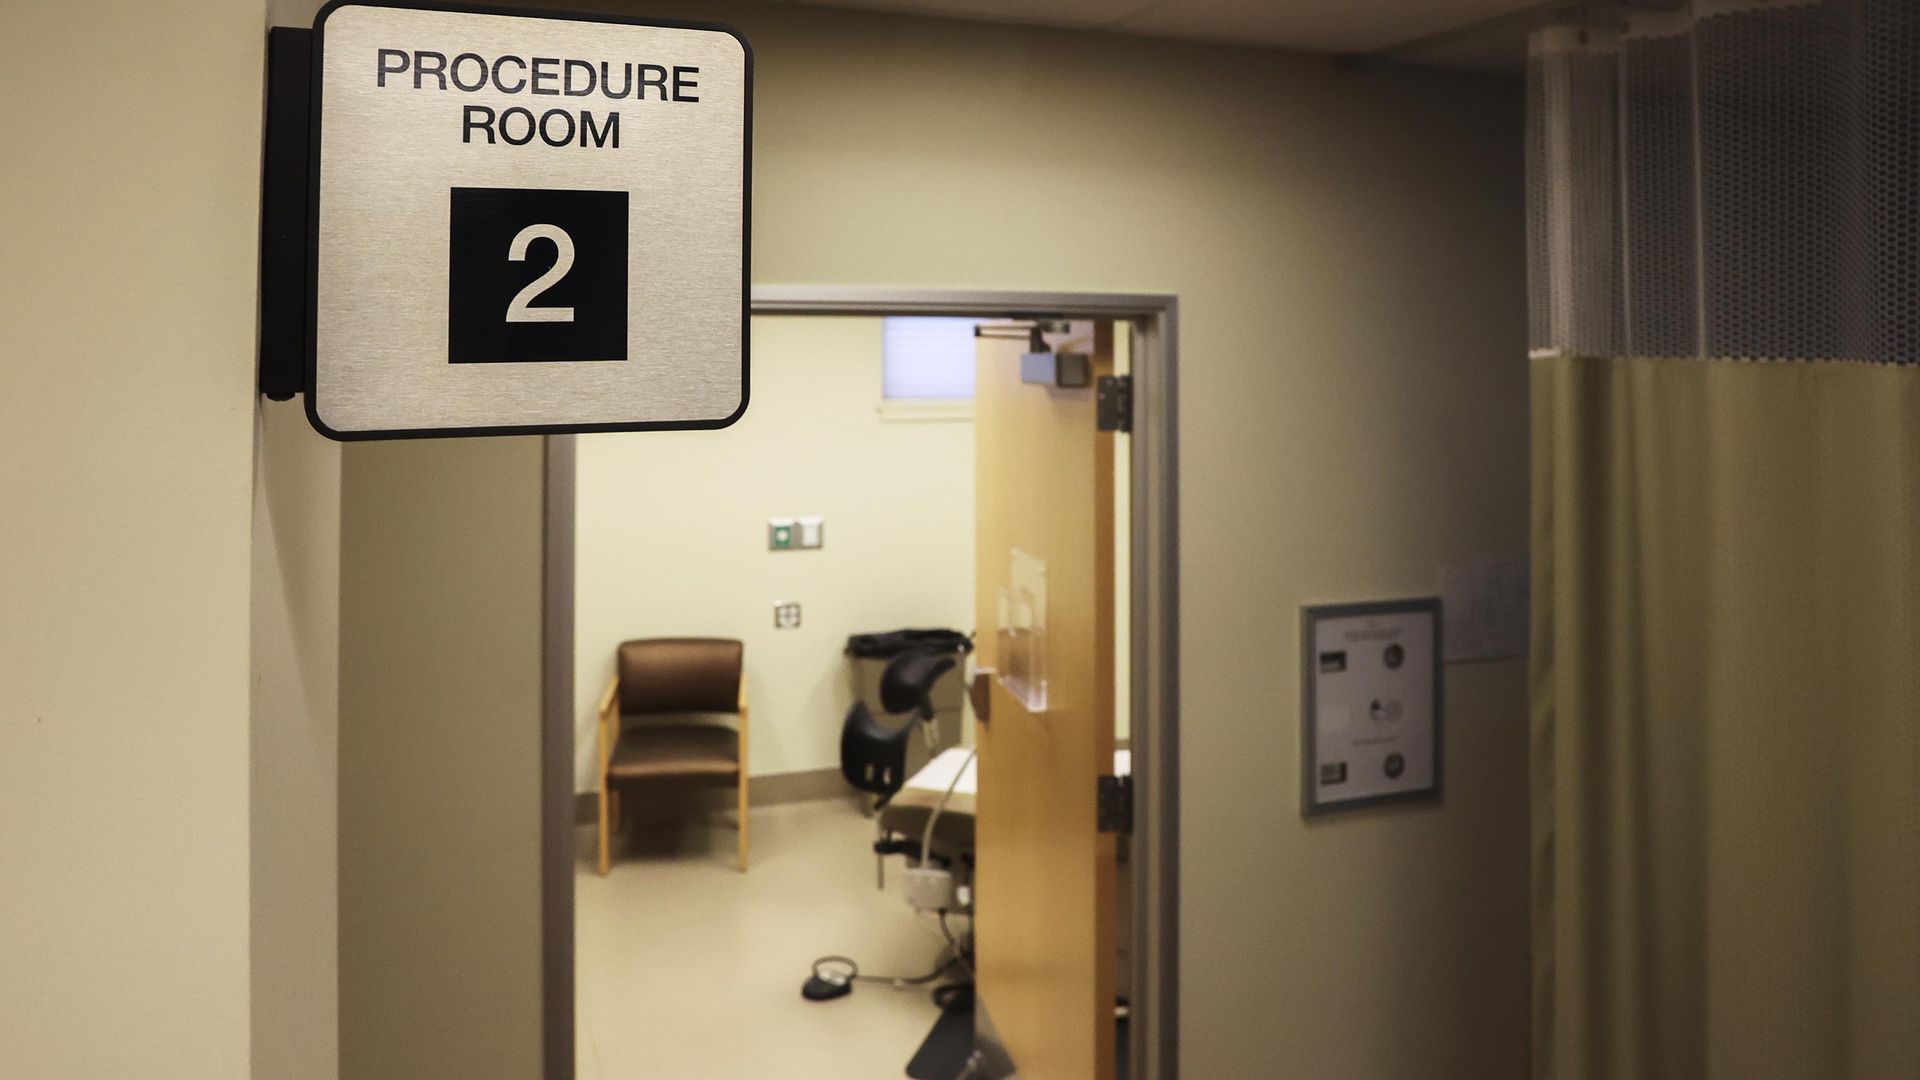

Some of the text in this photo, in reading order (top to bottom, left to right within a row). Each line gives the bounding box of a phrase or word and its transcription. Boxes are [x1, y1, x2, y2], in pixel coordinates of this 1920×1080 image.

[377, 48, 700, 103] PROCEDURE
[462, 105, 620, 149] ROOM
[505, 223, 576, 324] 2
